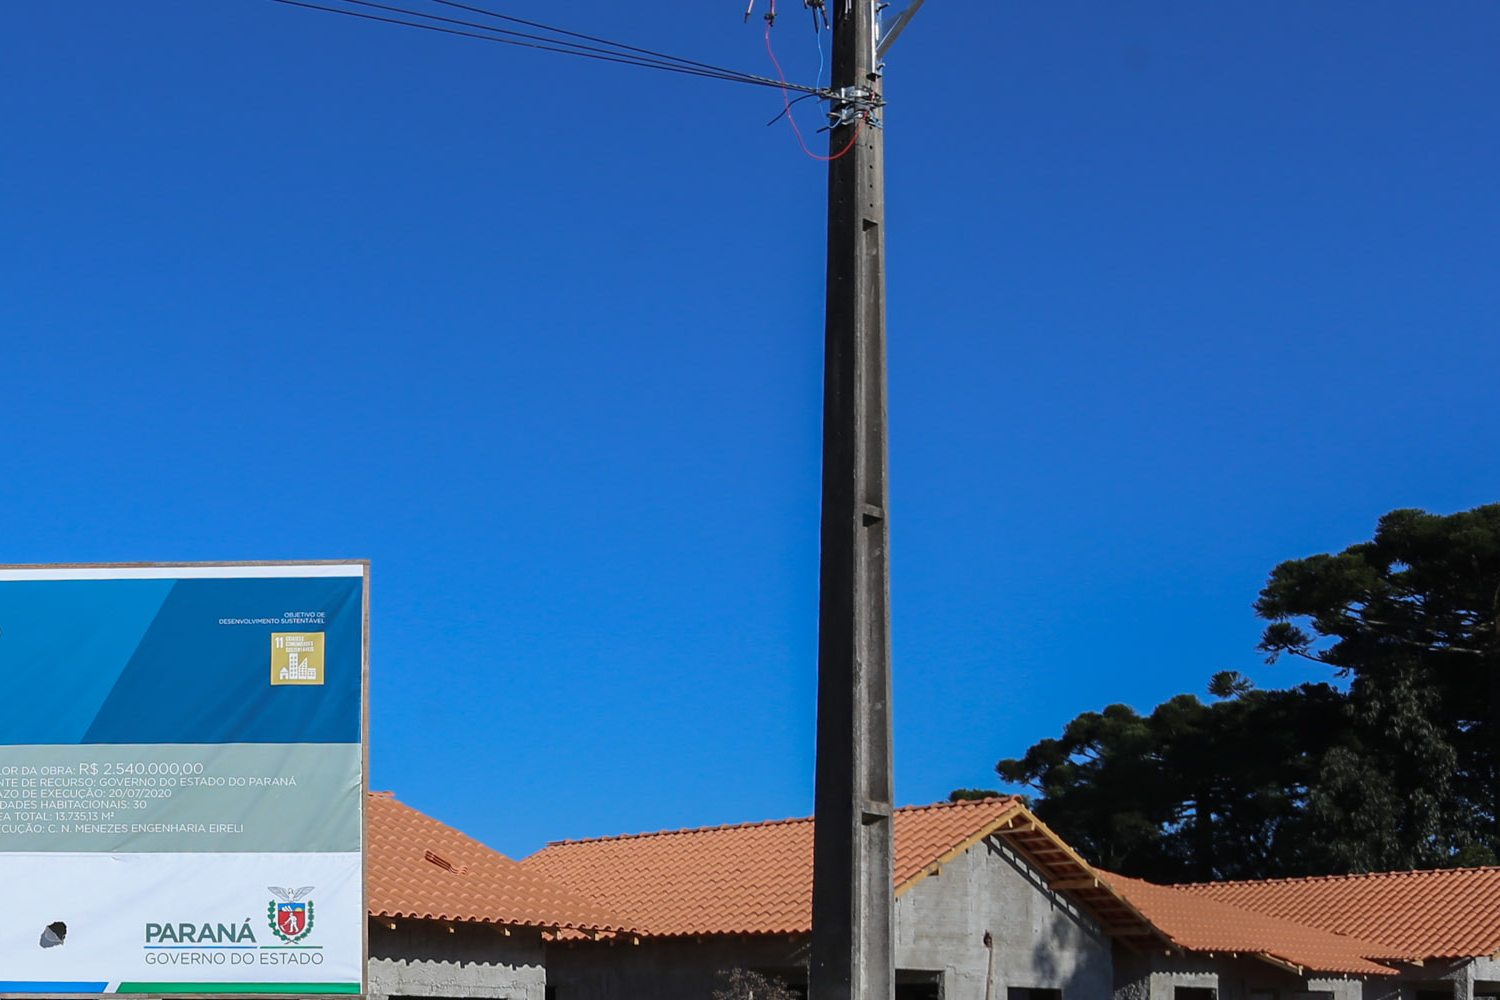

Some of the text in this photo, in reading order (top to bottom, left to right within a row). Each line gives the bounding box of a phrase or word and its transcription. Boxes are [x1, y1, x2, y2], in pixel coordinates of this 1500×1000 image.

[21, 766, 38, 776] DA
[40, 766, 76, 776] OBRA:
[78, 762, 99, 776] R$
[103, 762, 204, 776] 2.540.000,00
[21, 778, 37, 787] DE
[39, 777, 97, 787] RECURSO:
[99, 777, 156, 787] GOVERNO
[159, 777, 177, 787] DO
[180, 776, 225, 786] ESTADO
[228, 776, 246, 786] DO
[249, 776, 297, 786] PARANÁ
[22, 789, 37, 799] DE
[40, 788, 106, 800] EXECUÇÃO:
[108, 788, 172, 798] 20/07/2020
[40, 800, 130, 809] HABITACIONAIS:
[133, 800, 147, 809] 30
[14, 812, 52, 821] TOTAL:
[55, 812, 99, 821] 13.735,13
[101, 812, 115, 821] M²
[47, 824, 59, 833] C.
[61, 824, 72, 833] N.
[75, 824, 128, 833] MENEZES
[131, 823, 206, 833] ENGENHARIA
[209, 823, 244, 833] EIRELI
[145, 917, 257, 943] PARANÁ
[145, 952, 324, 965] GOVERNO DO ESTADO
